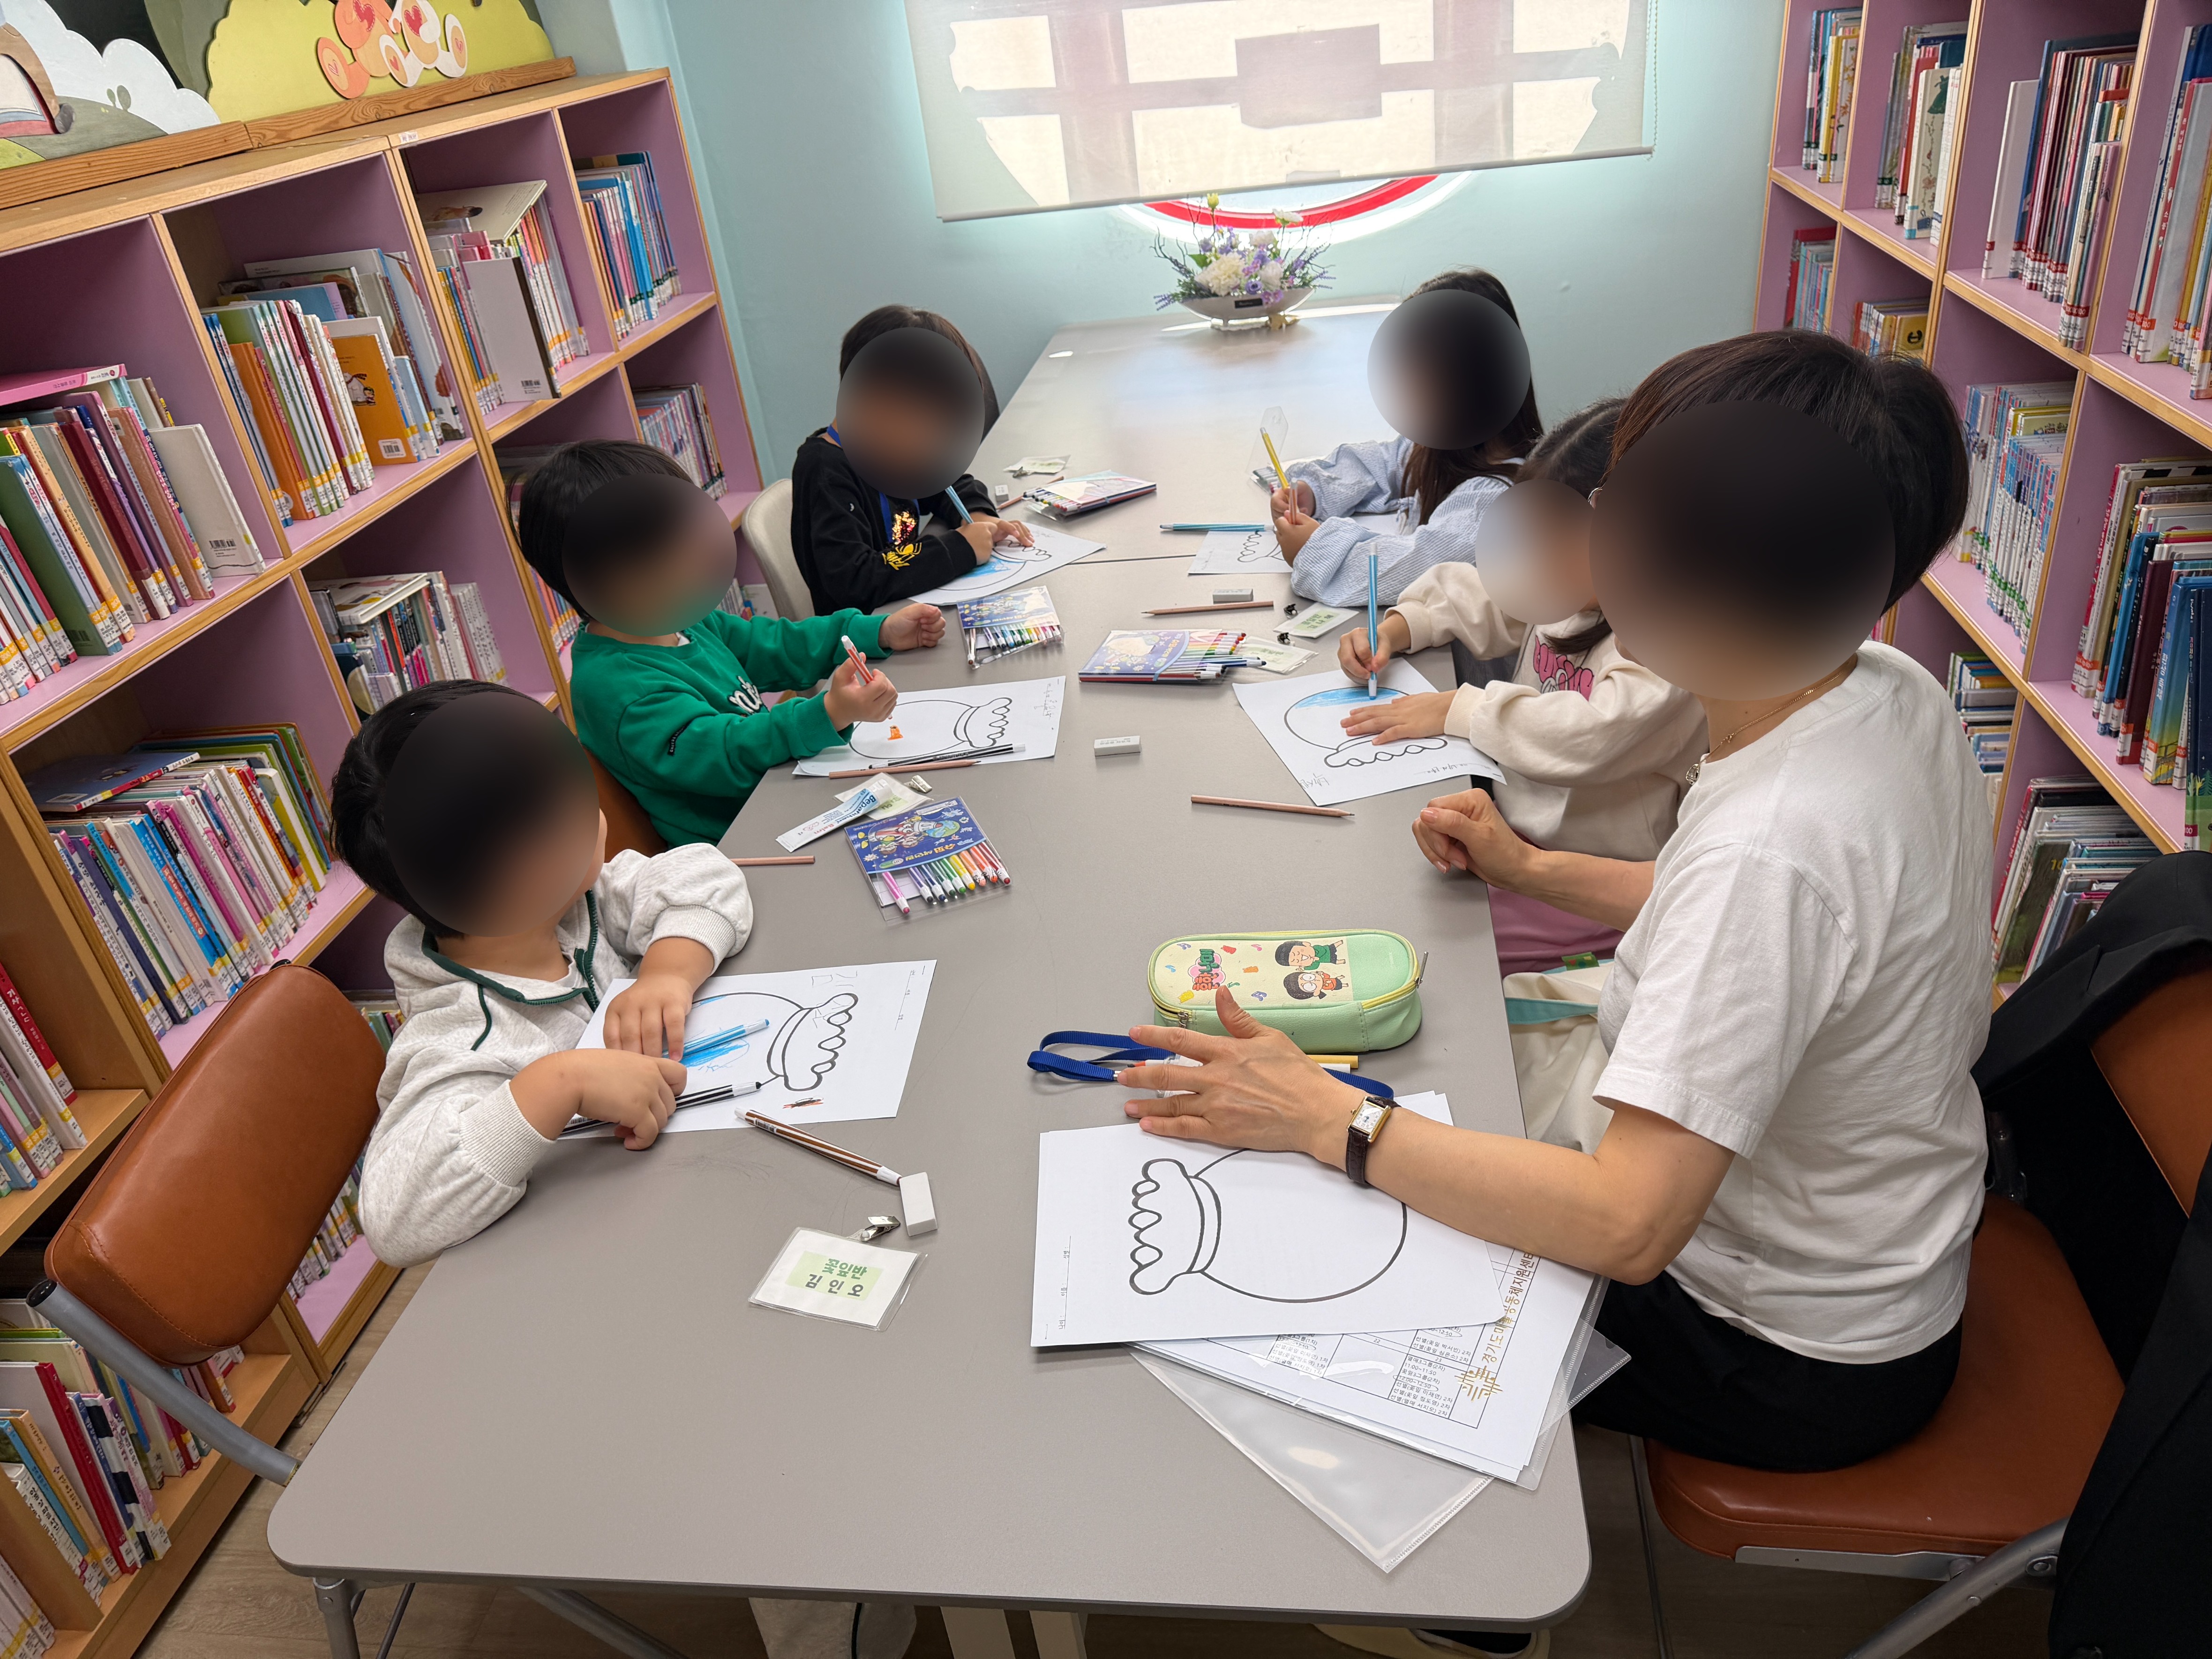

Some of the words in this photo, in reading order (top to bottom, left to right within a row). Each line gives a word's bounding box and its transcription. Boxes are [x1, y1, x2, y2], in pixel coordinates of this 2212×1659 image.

[1192, 949, 1220, 991] 흔한남매
[7, 988, 20, 1005] 기차
[15, 1005, 30, 1023] ㄱㄴㄷ
[822, 1258, 867, 1280] 꽃잎반
[805, 1273, 823, 1289] 김
[827, 1279, 844, 1294] 인
[847, 1284, 864, 1297] 오
[1058, 1320, 1065, 1329] 나이
[1404, 1363, 1437, 1376] 11:00~11:50
